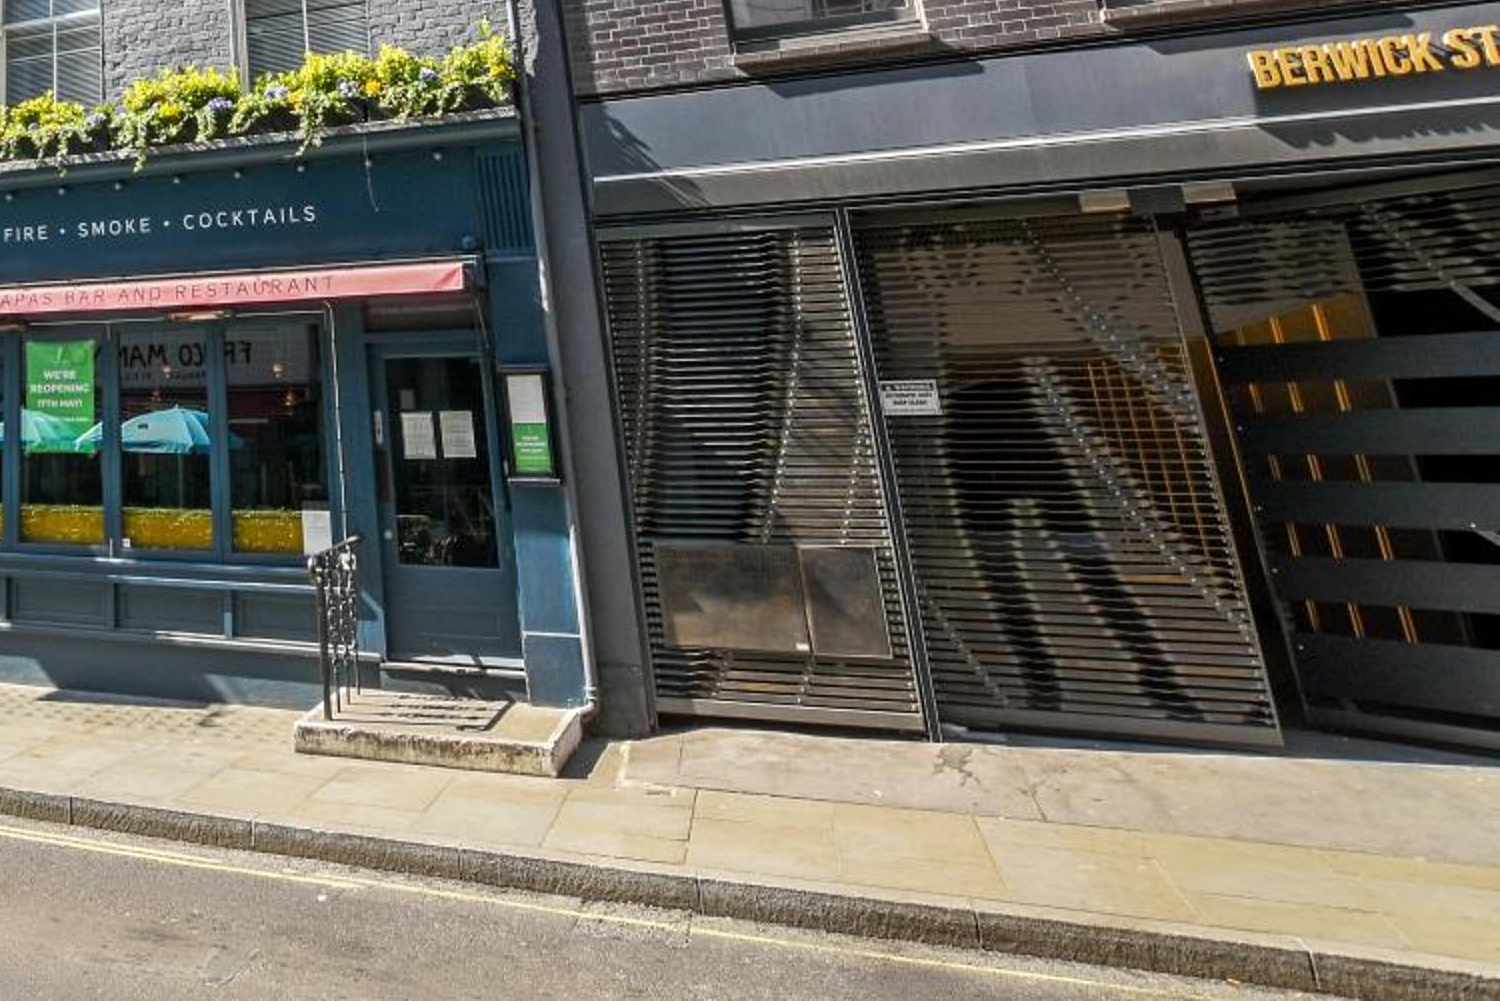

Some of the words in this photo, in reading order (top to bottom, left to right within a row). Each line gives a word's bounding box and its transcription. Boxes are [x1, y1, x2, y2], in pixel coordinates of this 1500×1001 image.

[1246, 32, 1444, 89] BERWICK
[3, 225, 48, 243] FIRE
[77, 217, 151, 238] SMOKE
[182, 205, 316, 230] COCKTAILS
[65, 289, 105, 304] BAR
[118, 286, 161, 301] AND
[175, 276, 333, 299] RESTAURANT
[29, 383, 92, 394] REOPENING
[43, 369, 77, 380] WE'RE
